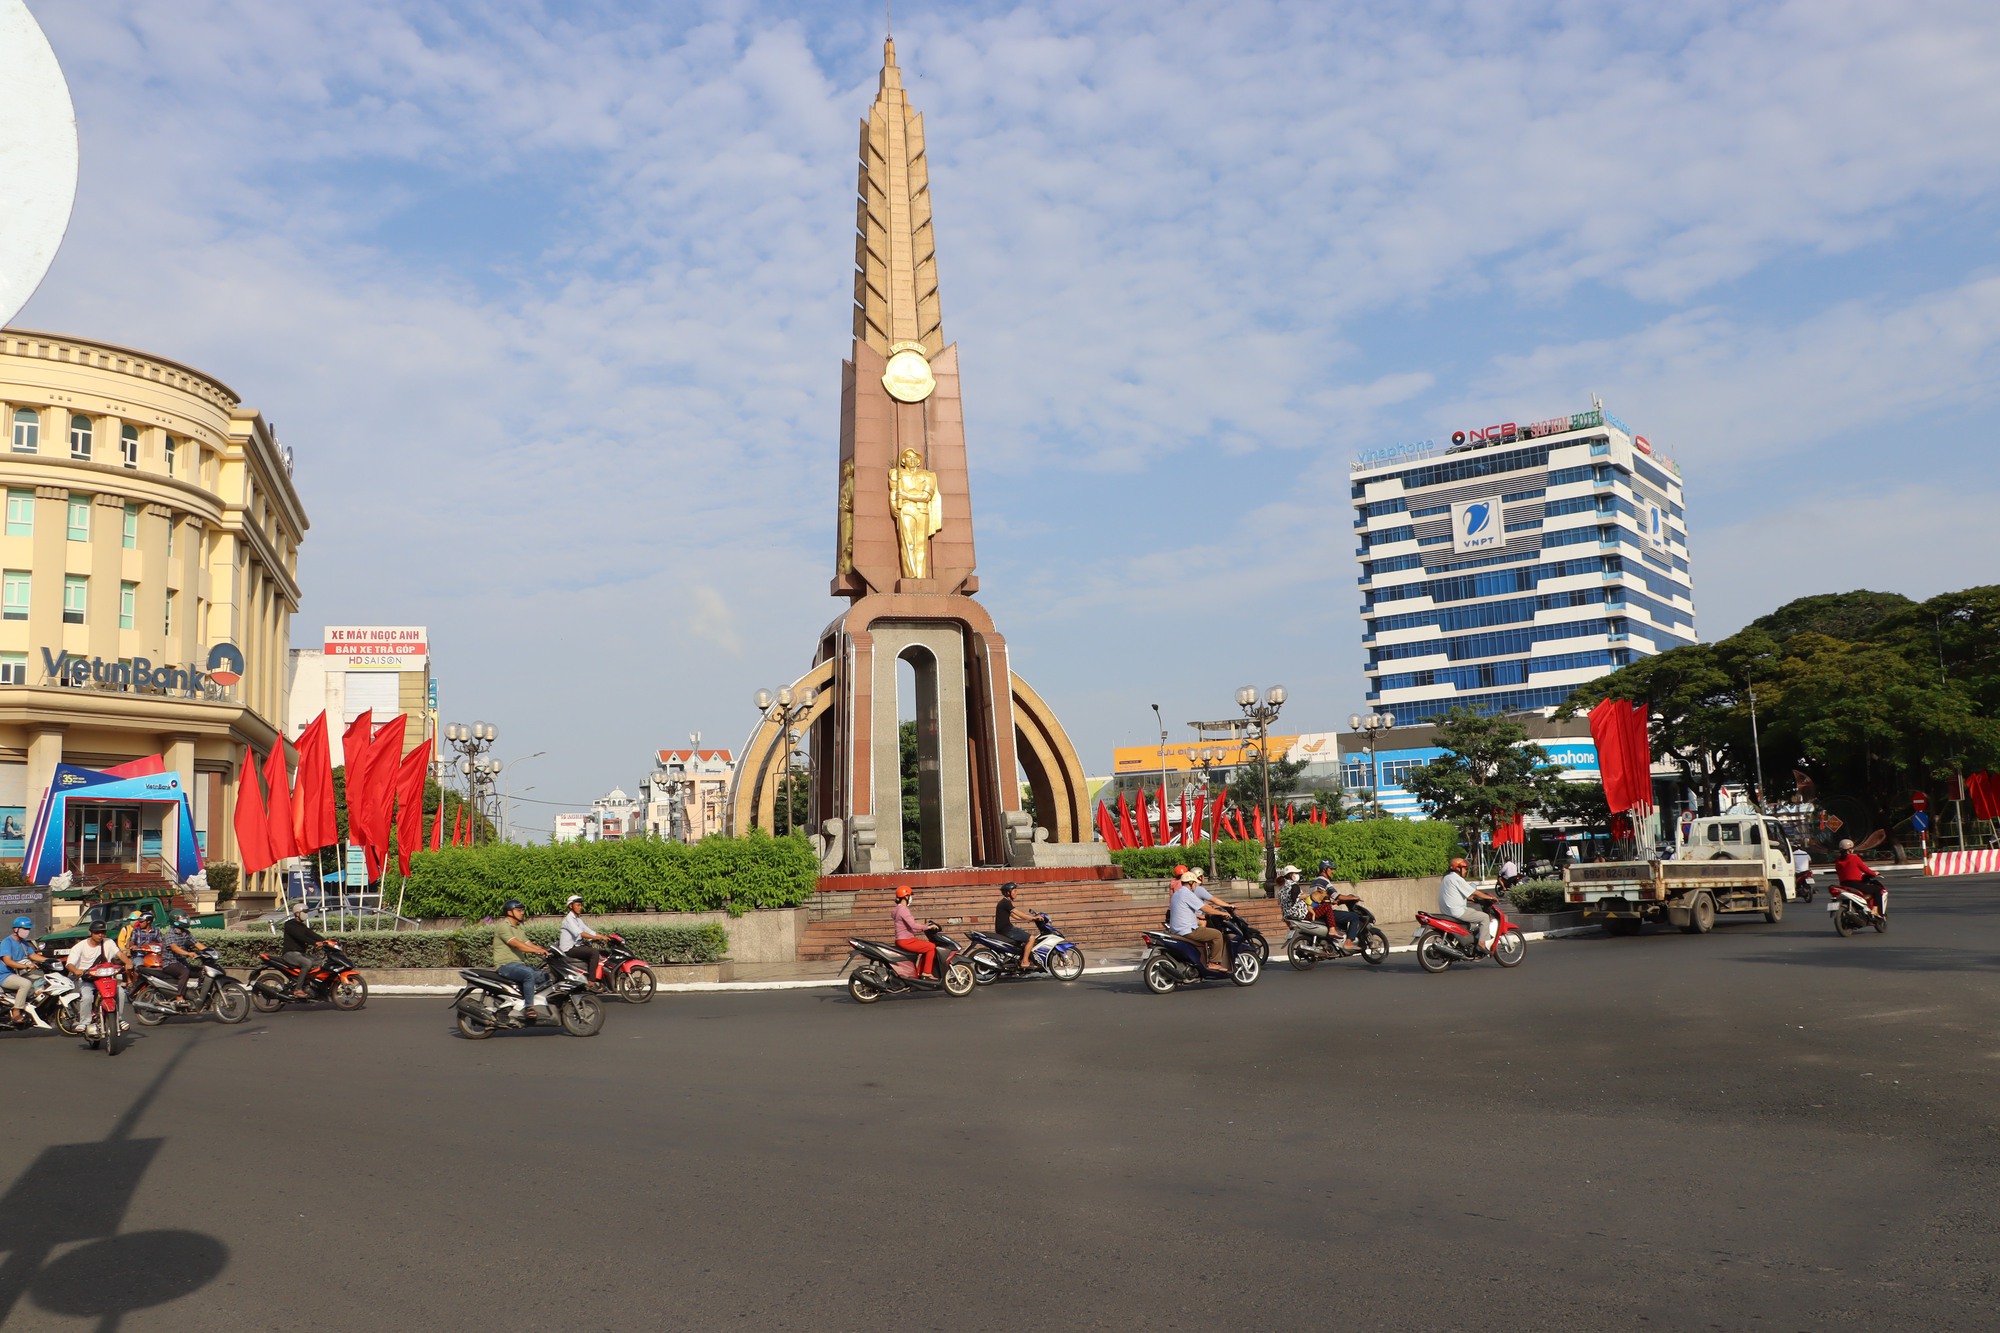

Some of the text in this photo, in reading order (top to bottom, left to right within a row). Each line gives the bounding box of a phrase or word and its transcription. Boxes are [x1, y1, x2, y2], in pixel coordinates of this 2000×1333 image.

[1530, 422, 1549, 438] SAO
[1550, 417, 1570, 433] KIM
[1571, 410, 1604, 430] HOTEL
[1469, 422, 1517, 442] NCB
[1463, 537, 1494, 547] VNPT
[331, 628, 420, 642] XE MÁY NGỌC ANH
[335, 643, 415, 654] BÁN XE TRẢ GÓP
[349, 656, 402, 665] HD SAISON
[40, 646, 206, 692] VietinBank
[62, 774, 73, 783] 35
